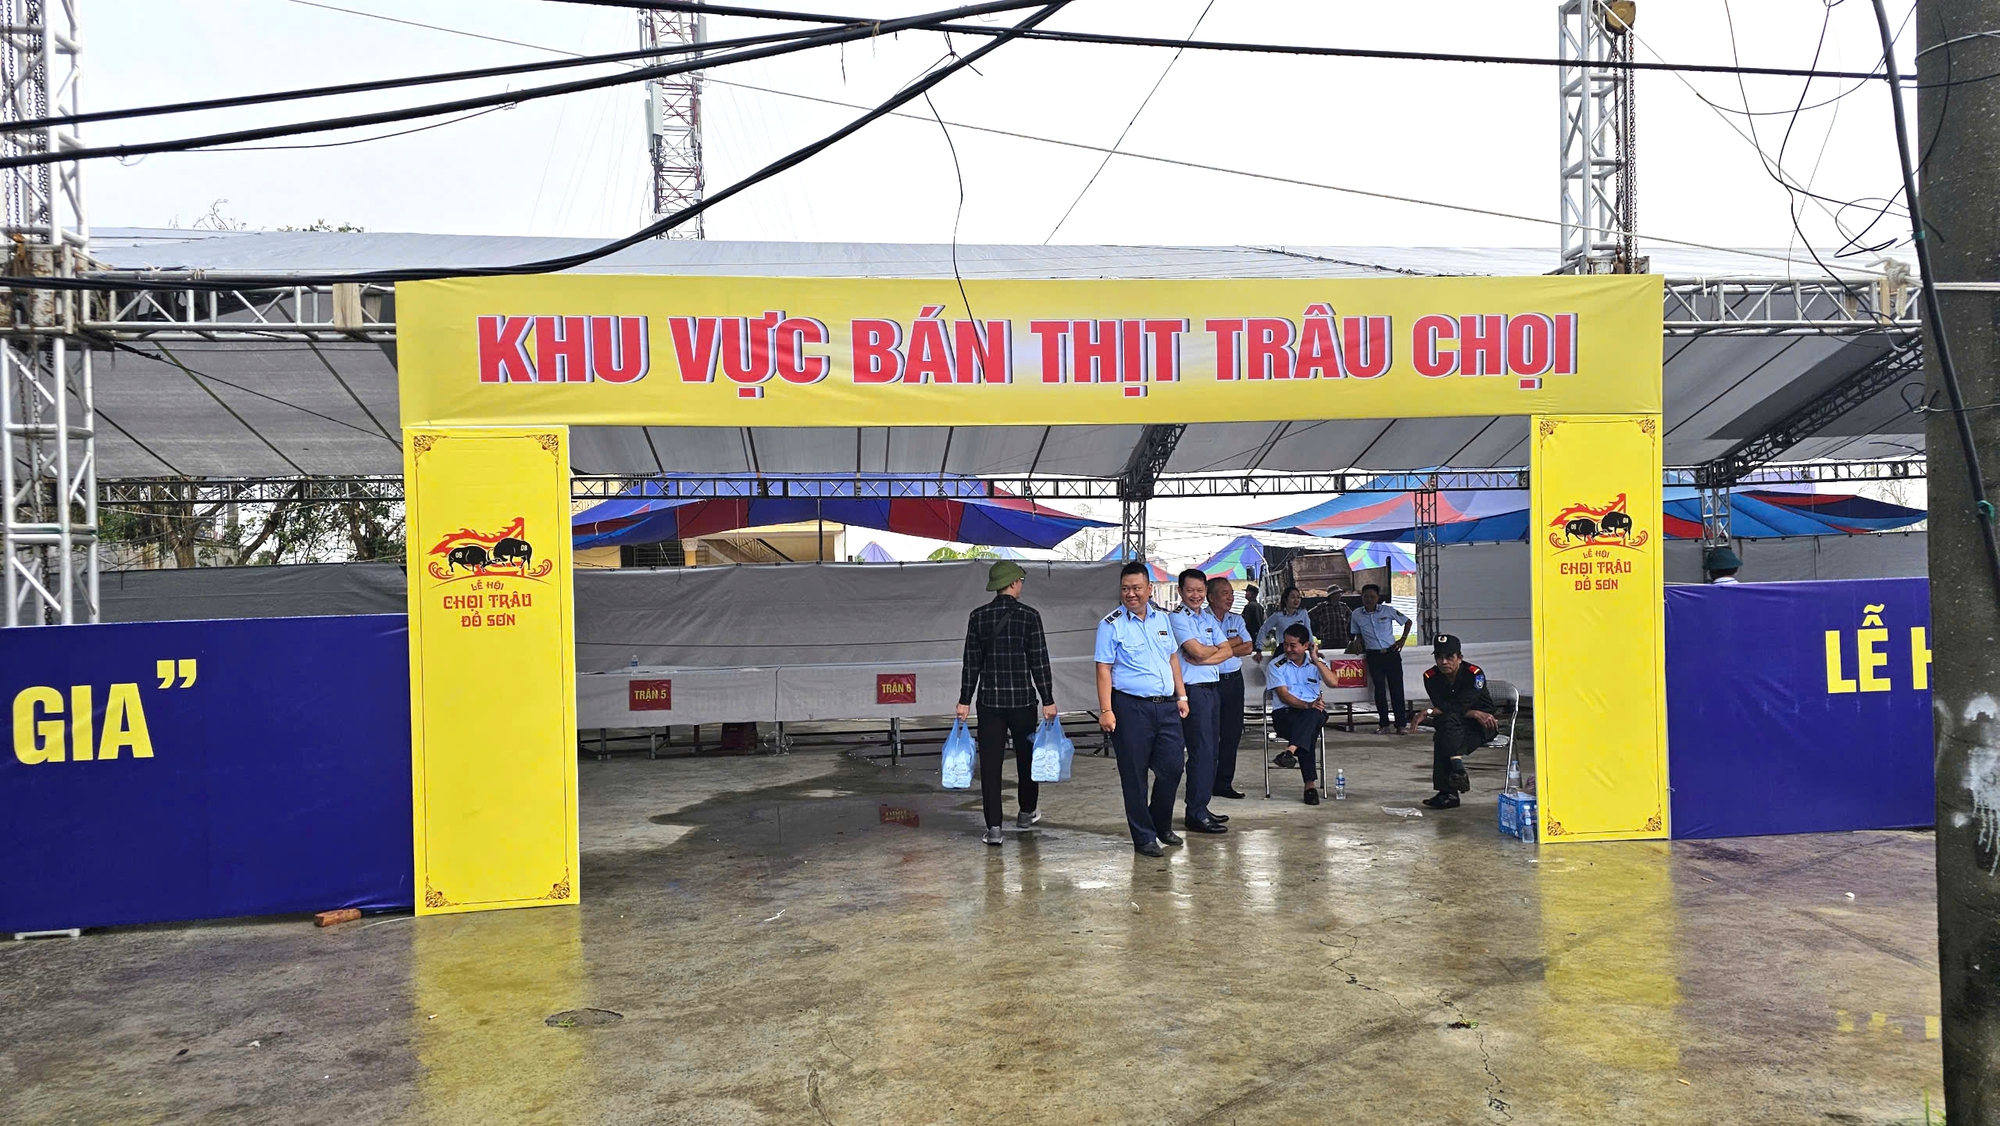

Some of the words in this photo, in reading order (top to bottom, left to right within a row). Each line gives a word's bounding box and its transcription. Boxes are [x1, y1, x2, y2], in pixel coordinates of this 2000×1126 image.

[477, 314, 649, 384] KHU
[669, 309, 832, 399] VỰC
[851, 304, 1011, 386] BÁN
[1029, 317, 1190, 398] THỊT
[1205, 302, 1393, 381] TRÂU
[1411, 311, 1578, 390] CHỌI
[1560, 562, 1593, 577] CHỌI
[1596, 558, 1632, 575] TRÂU
[1595, 577, 1619, 591] SƠN
[443, 595, 484, 612] CHỌI
[488, 590, 532, 610] TRÂU
[486, 612, 516, 627] SƠN
[1825, 603, 1892, 694] LỄ
[1335, 666, 1357, 680] TRẬN
[633, 687, 659, 702] TRẬN
[660, 690, 667, 699] 5
[881, 682, 904, 695] TRẬN
[906, 683, 912, 693] 6
